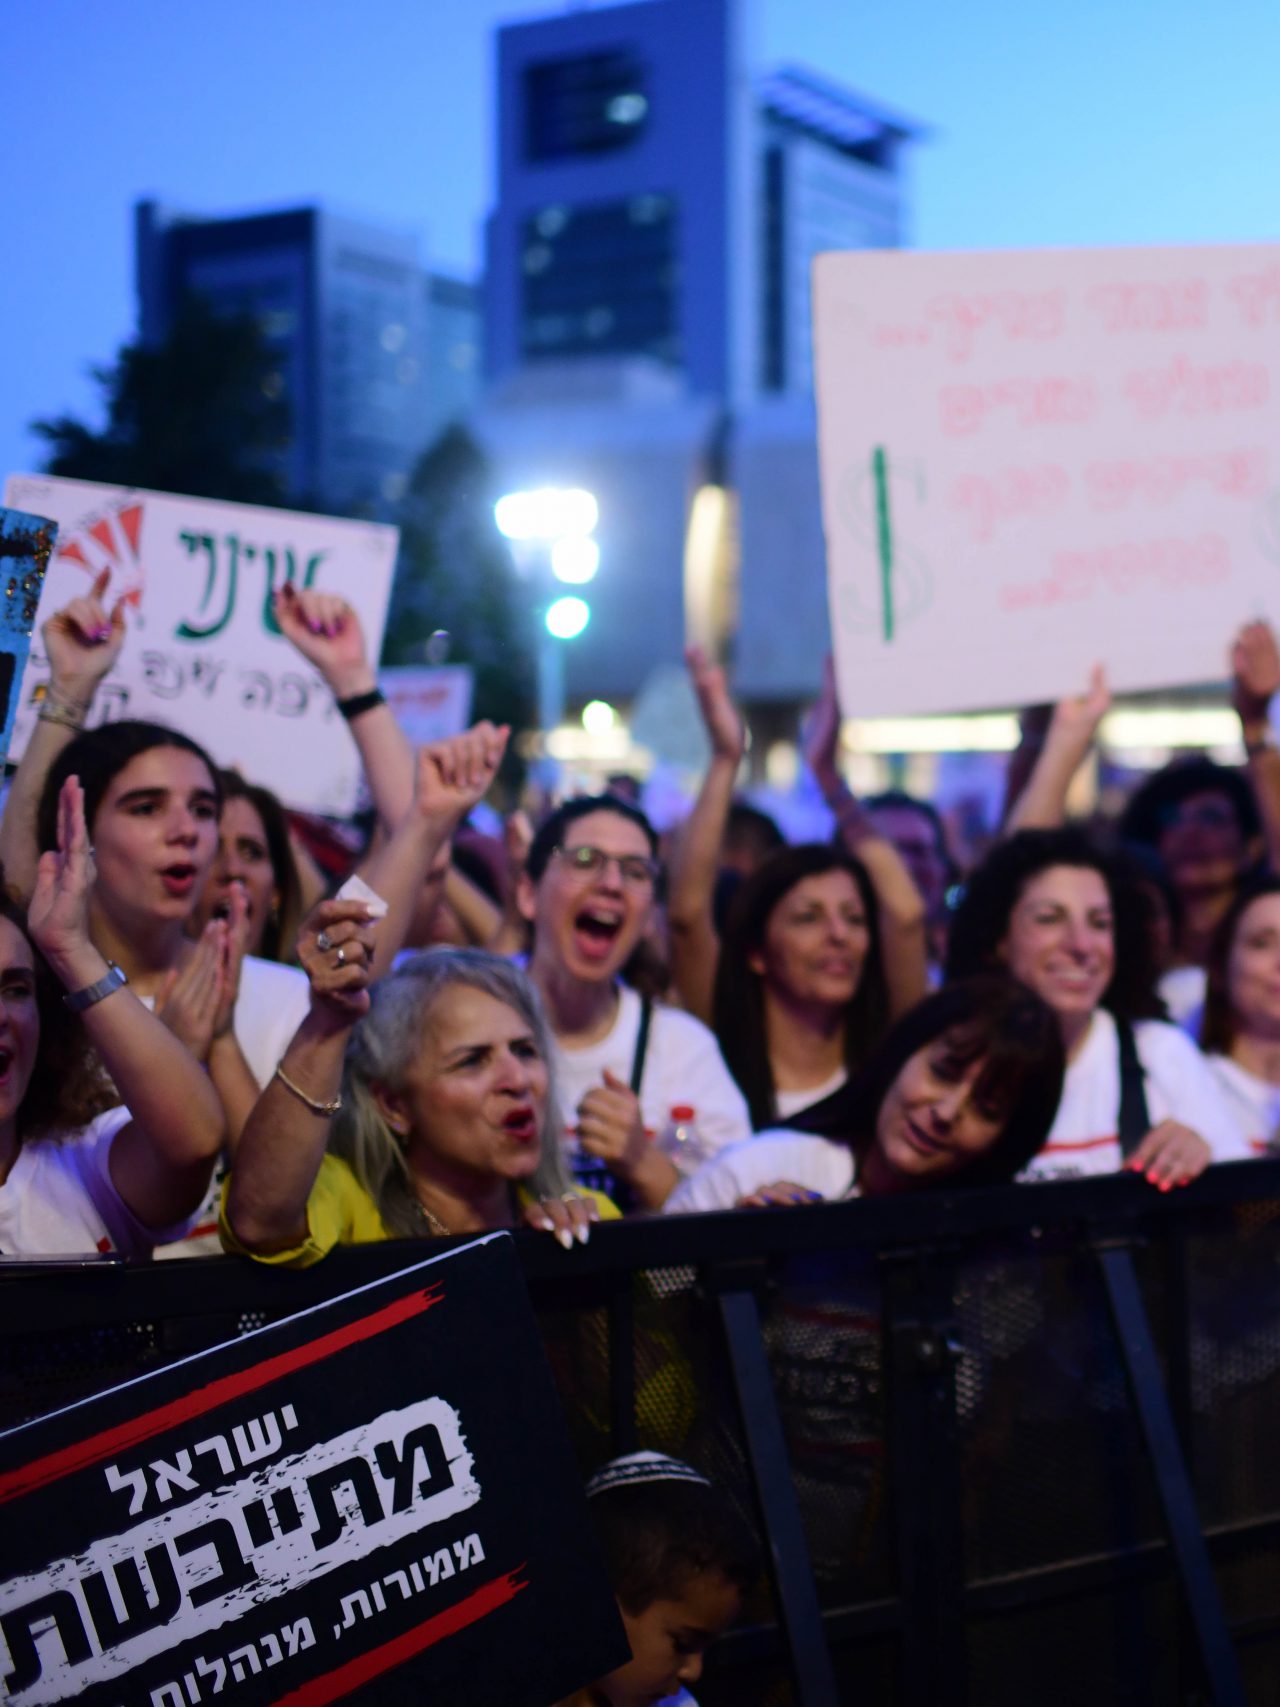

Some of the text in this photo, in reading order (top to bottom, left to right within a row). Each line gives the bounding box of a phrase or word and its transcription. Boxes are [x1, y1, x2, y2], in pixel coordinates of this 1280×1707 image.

[104, 1403, 299, 1516] ישראל
[0, 1422, 456, 1697] מתייבשת
[333, 1532, 486, 1641] ממורות,
